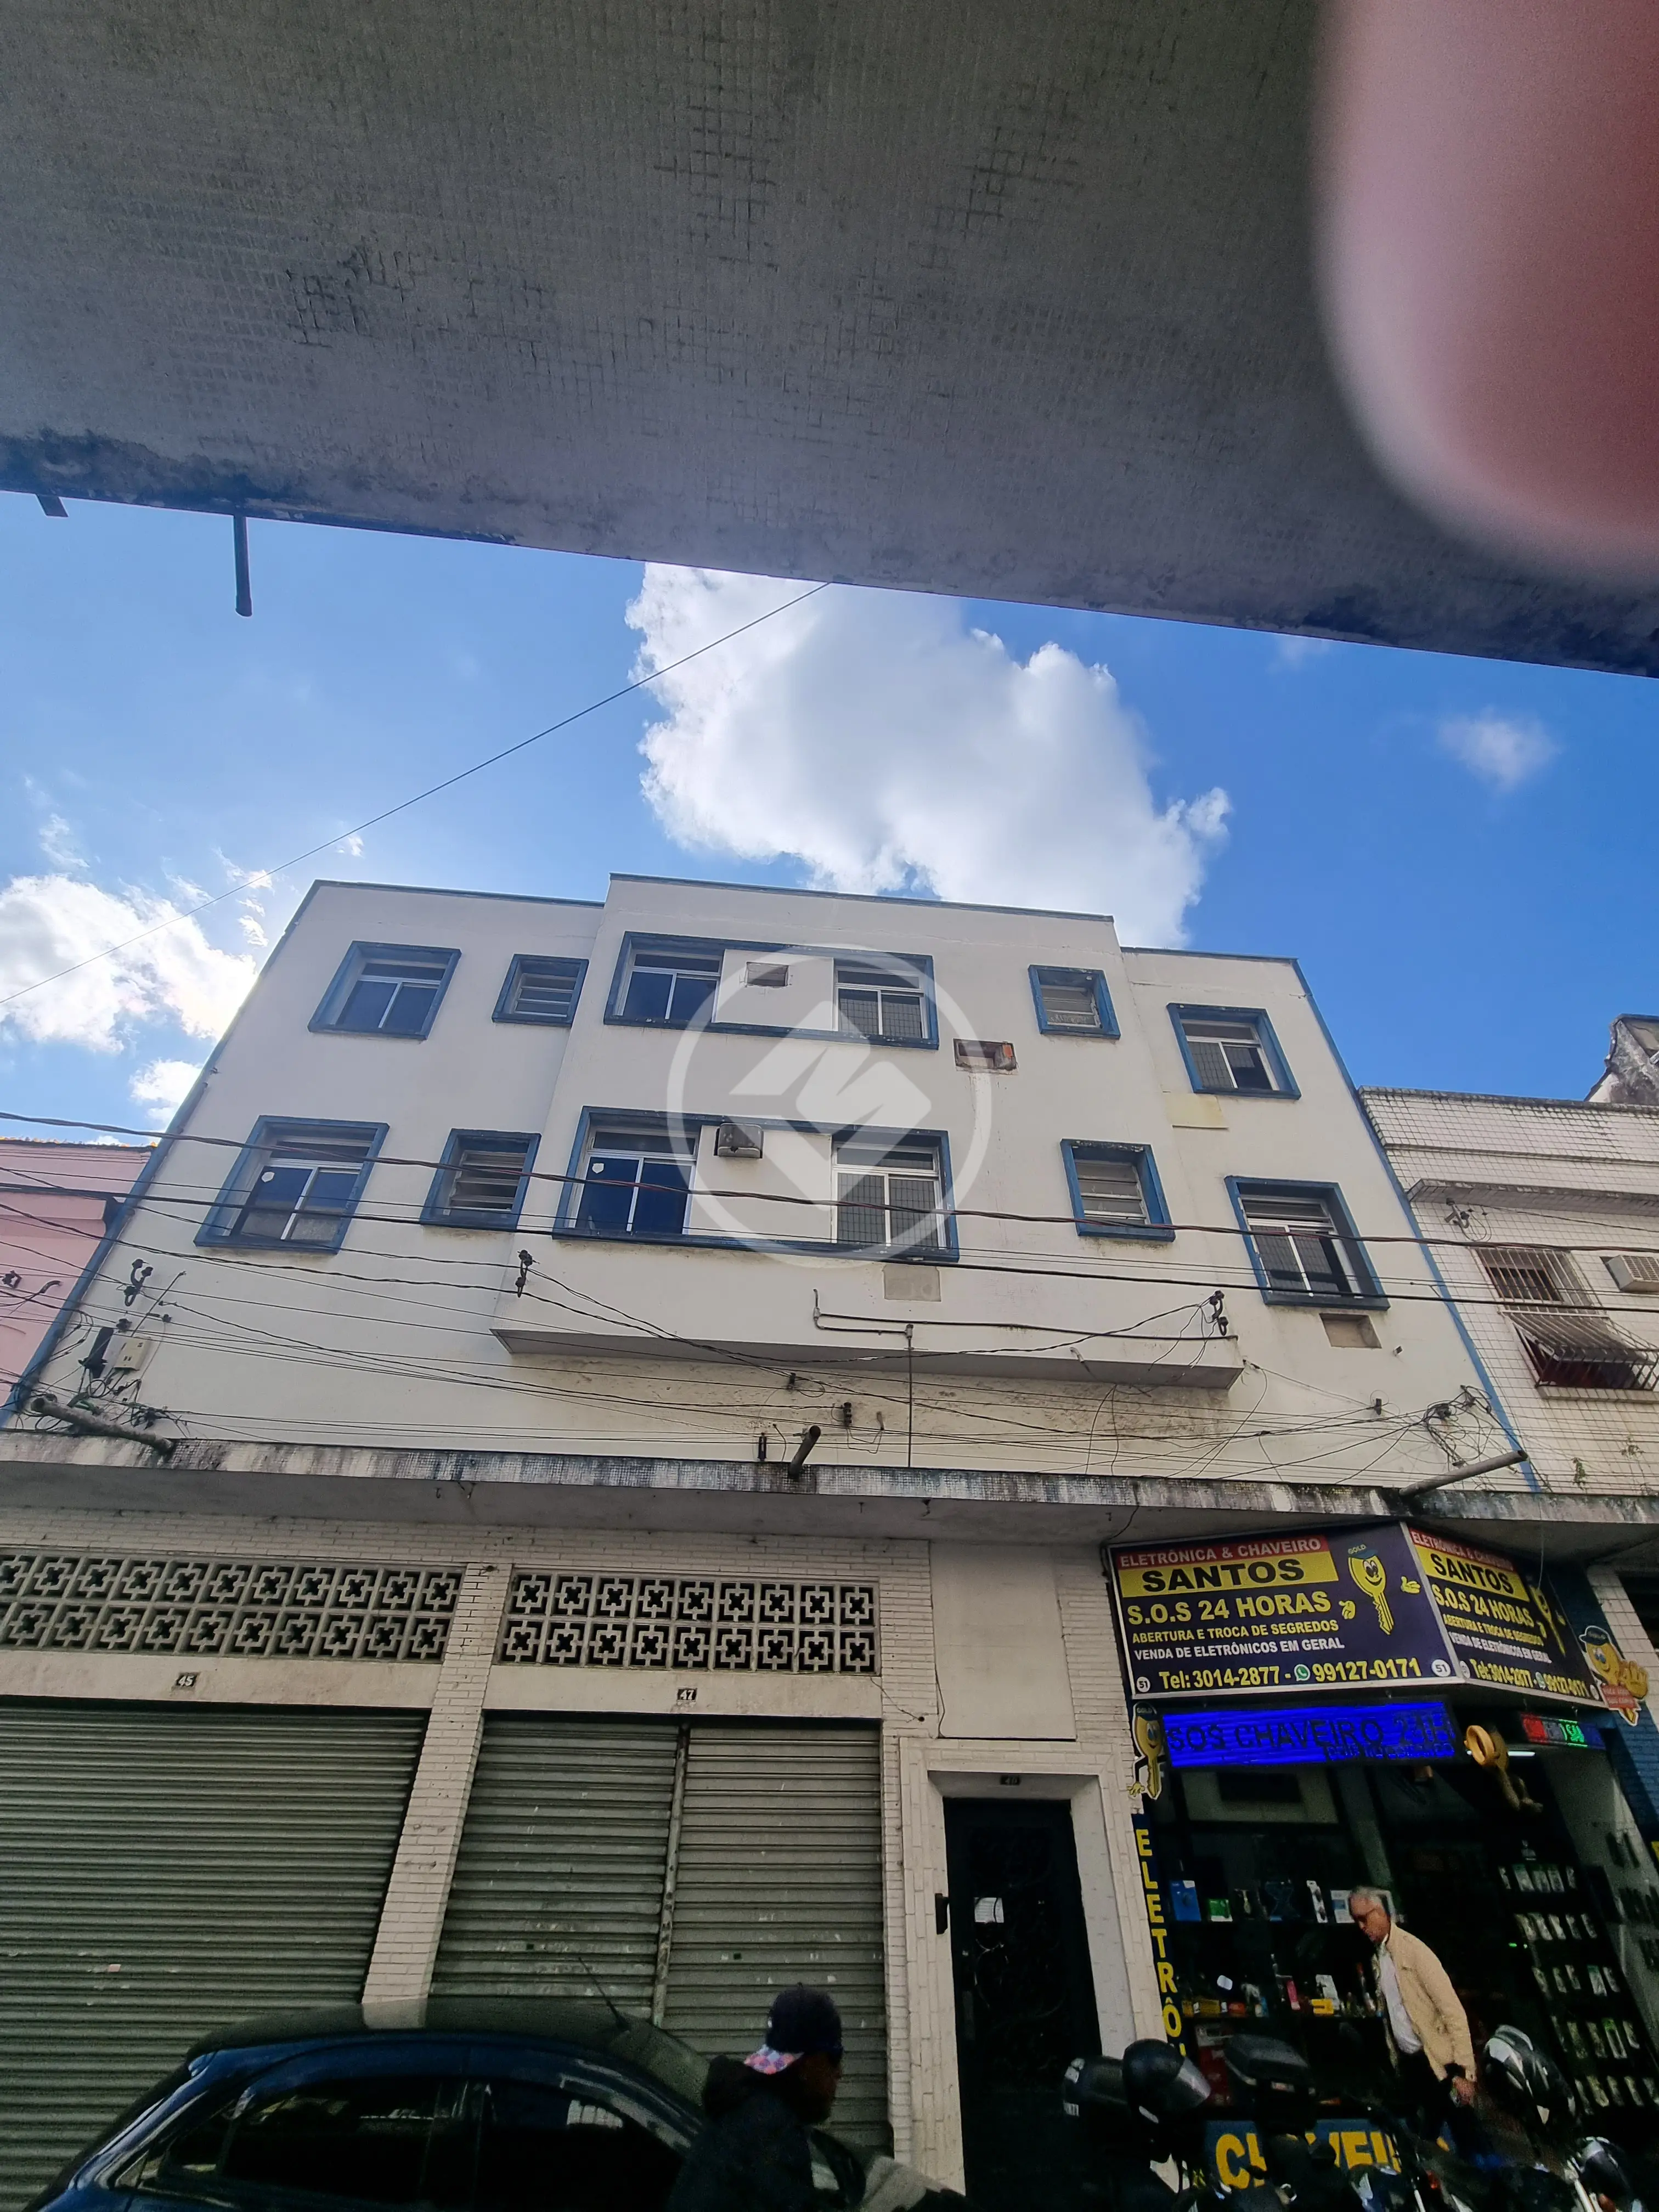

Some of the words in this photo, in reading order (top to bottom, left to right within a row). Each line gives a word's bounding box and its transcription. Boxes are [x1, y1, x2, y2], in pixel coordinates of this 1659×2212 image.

[1121, 1549, 1216, 1567] ELETRÔNICA
[1222, 1547, 1233, 1558] &
[1238, 1538, 1322, 1557] CHAVEIRO
[1348, 1544, 1367, 1554] GOLD
[1142, 1559, 1304, 1592] SANTOS
[1431, 1553, 1514, 1594] SANTOS
[1127, 1602, 1192, 1625] S.O.S
[1198, 1599, 1229, 1620] 24
[1236, 1592, 1331, 1617] HORAS
[1431, 1584, 1471, 1612] S.O.S
[1470, 1594, 1490, 1617] 24
[1488, 1598, 1534, 1628] HORAS
[1132, 1630, 1195, 1644] ABERTURA
[1197, 1629, 1205, 1639] E
[1207, 1626, 1249, 1639] TROCA
[1251, 1624, 1268, 1636] DE
[1271, 1620, 1339, 1635] SEGREDOS
[1135, 1649, 1173, 1661] VENDA
[1176, 1647, 1192, 1658] DE
[1194, 1641, 1278, 1657] ELETRÔNICOS
[1279, 1640, 1300, 1652] EM
[1301, 1637, 1345, 1651] GERAL
[179, 1675, 195, 1686] 45
[1312, 1657, 1422, 1683] 99127-0171
[1435, 1664, 1448, 1673] 51
[680, 1690, 694, 1700] 47
[1139, 1680, 1148, 1689] 51
[1167, 1724, 1226, 1751] SOS
[1235, 1718, 1384, 1748] CHAVEIRO
[1136, 1829, 1186, 2056] ELETRÔ
